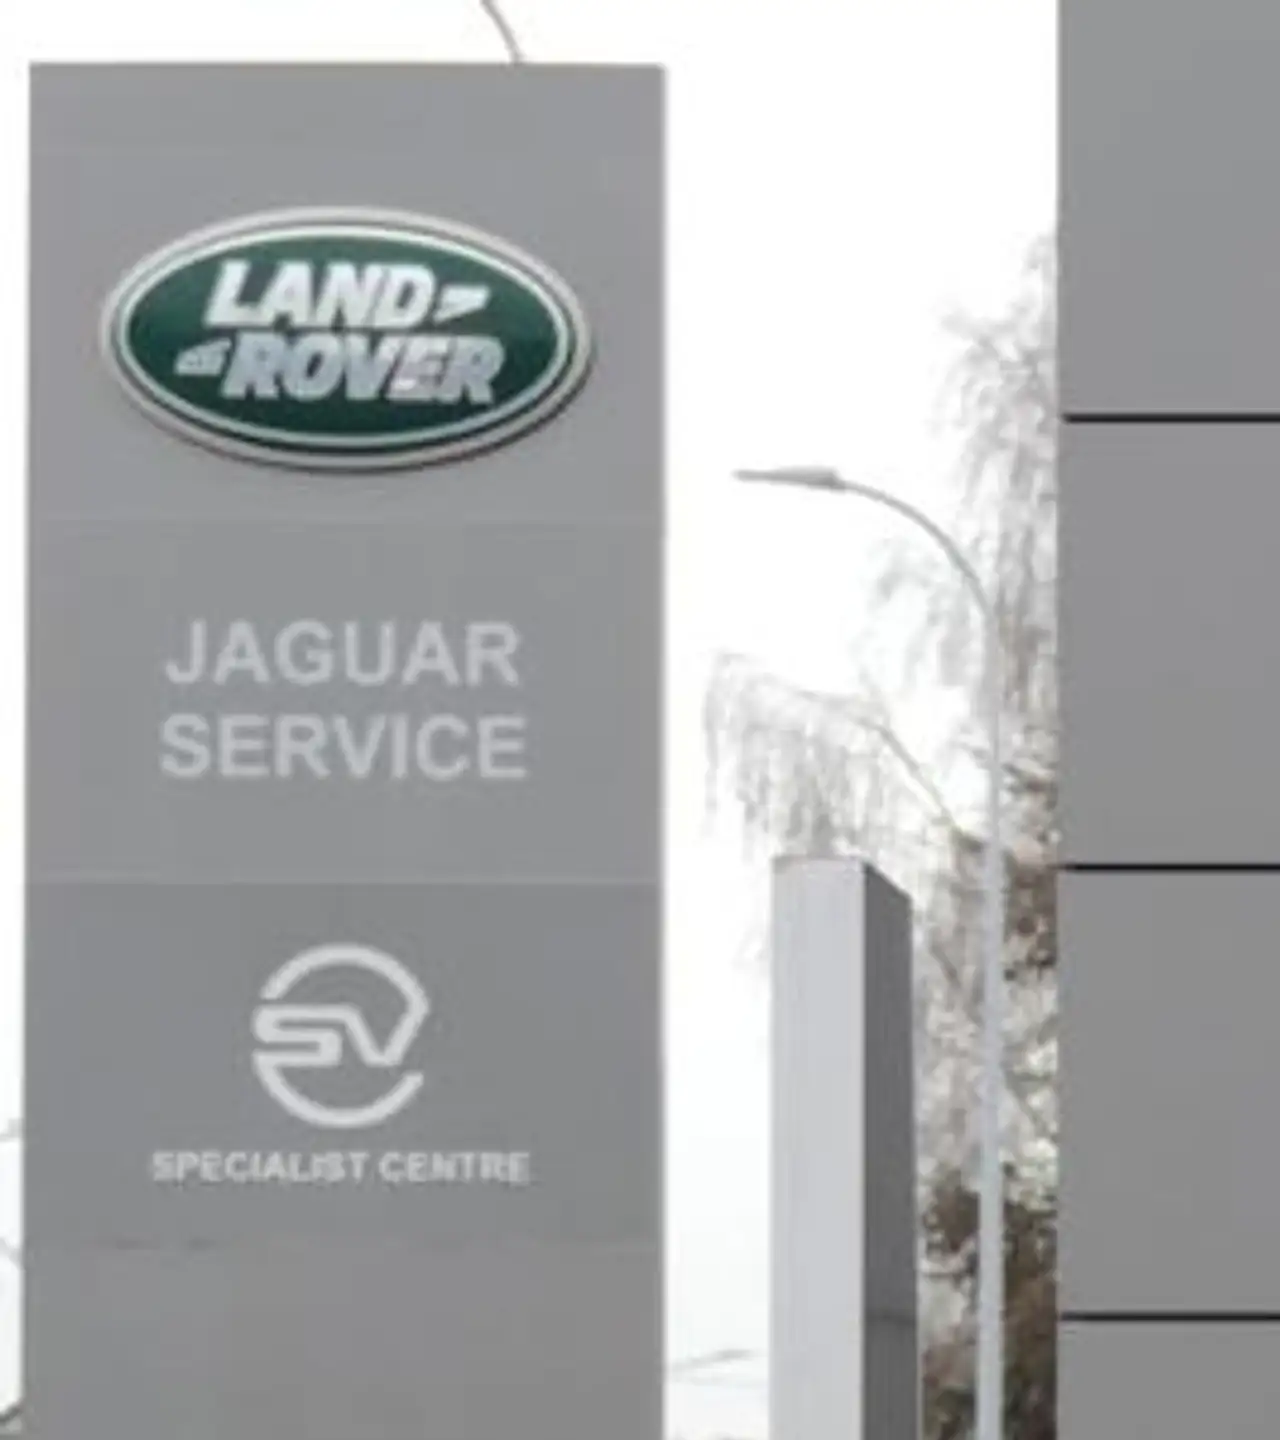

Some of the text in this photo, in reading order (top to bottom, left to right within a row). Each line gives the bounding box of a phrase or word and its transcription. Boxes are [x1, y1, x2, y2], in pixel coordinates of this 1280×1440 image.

[205, 260, 436, 328] LAND
[220, 333, 506, 403] ROVER
[163, 619, 522, 686] JAGUAR
[158, 714, 530, 780] SERVICE
[150, 1150, 532, 1183] SPECIALIST CENTRE
